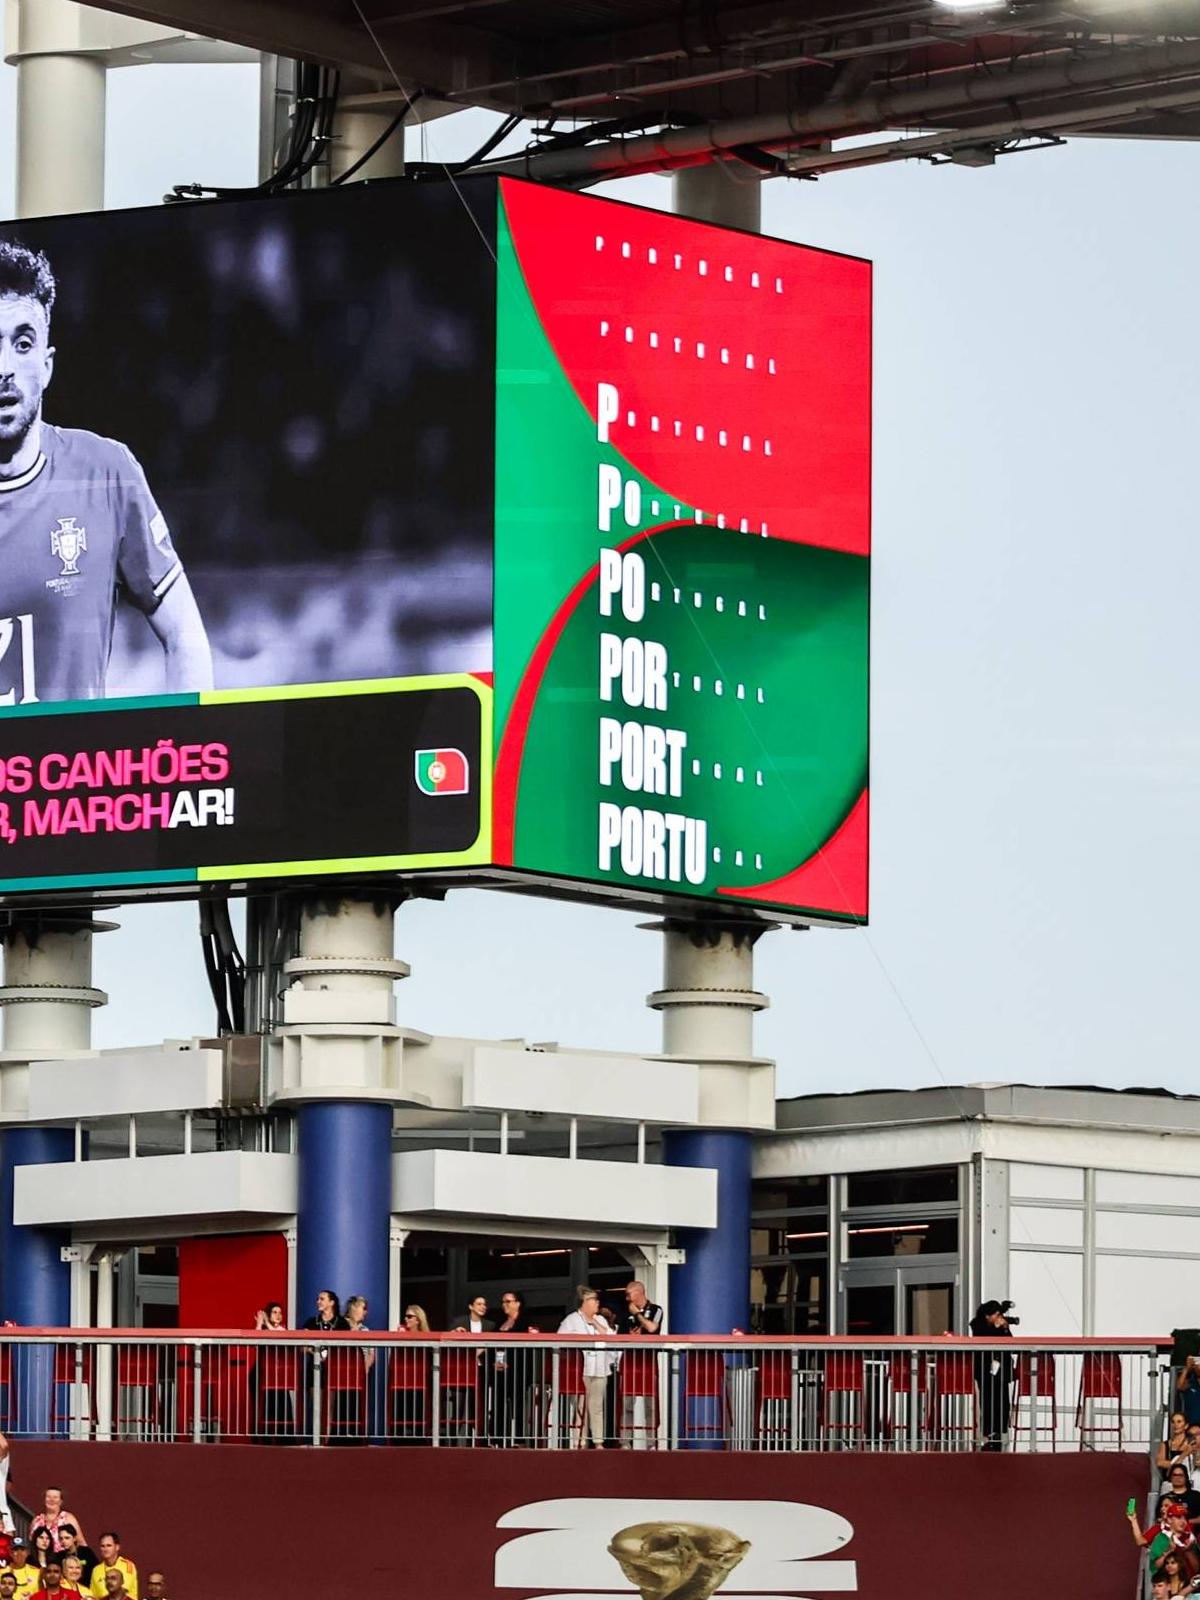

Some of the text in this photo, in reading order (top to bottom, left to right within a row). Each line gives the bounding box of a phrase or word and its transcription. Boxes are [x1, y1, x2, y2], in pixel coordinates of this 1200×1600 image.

[595, 236, 783, 293] PORTUGAL
[600, 321, 776, 374] PORTUGAL
[39, 738, 229, 791] CANHÕES
[24, 787, 235, 837] MARCHAR!
